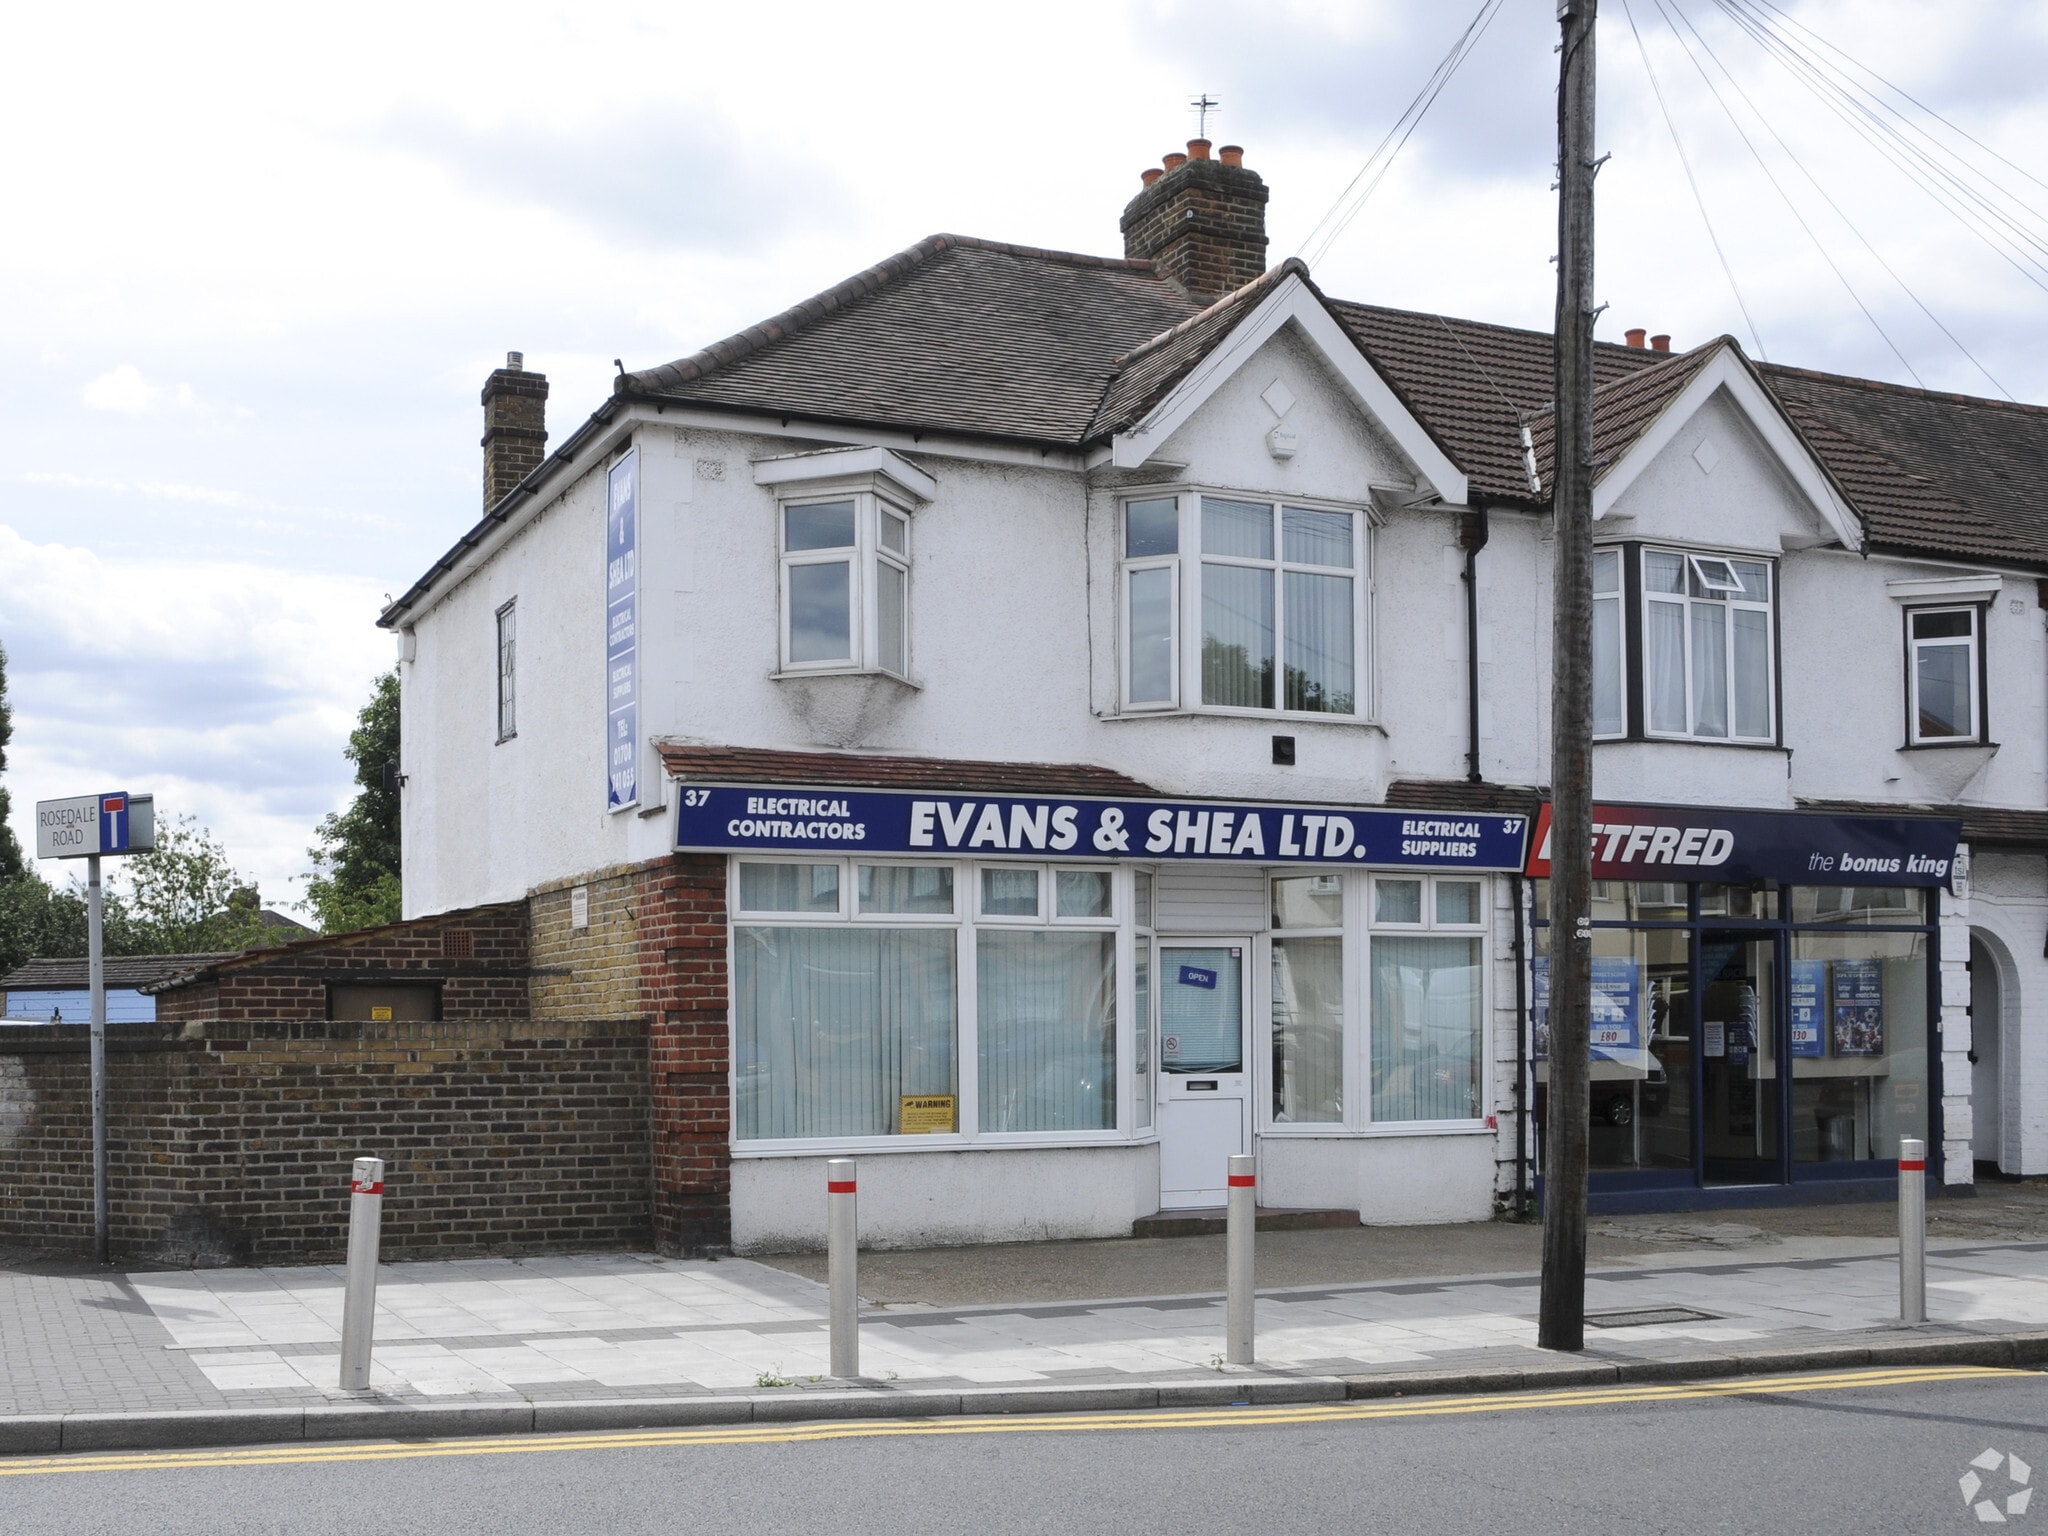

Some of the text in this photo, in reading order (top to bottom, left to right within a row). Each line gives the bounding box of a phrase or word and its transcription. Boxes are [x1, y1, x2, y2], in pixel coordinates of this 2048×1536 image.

[685, 790, 711, 807] 37
[747, 797, 850, 817] ELECTRICAL
[40, 806, 96, 827] ROSEDALE
[727, 819, 866, 840] CONTRACTORS
[909, 801, 1367, 859] EVANS & SHEA LTD.
[1401, 820, 1481, 838] ELECTRICAL
[1502, 819, 1522, 835] 37
[52, 828, 84, 847] ROAD
[1538, 823, 1735, 866] TFRED
[1401, 840, 1477, 858] SUPPLIERS
[1808, 852, 1949, 877] the bonus king
[1187, 972, 1209, 983] OPEN
[1600, 1031, 1618, 1042] £80
[915, 1100, 952, 1109] WARNING
